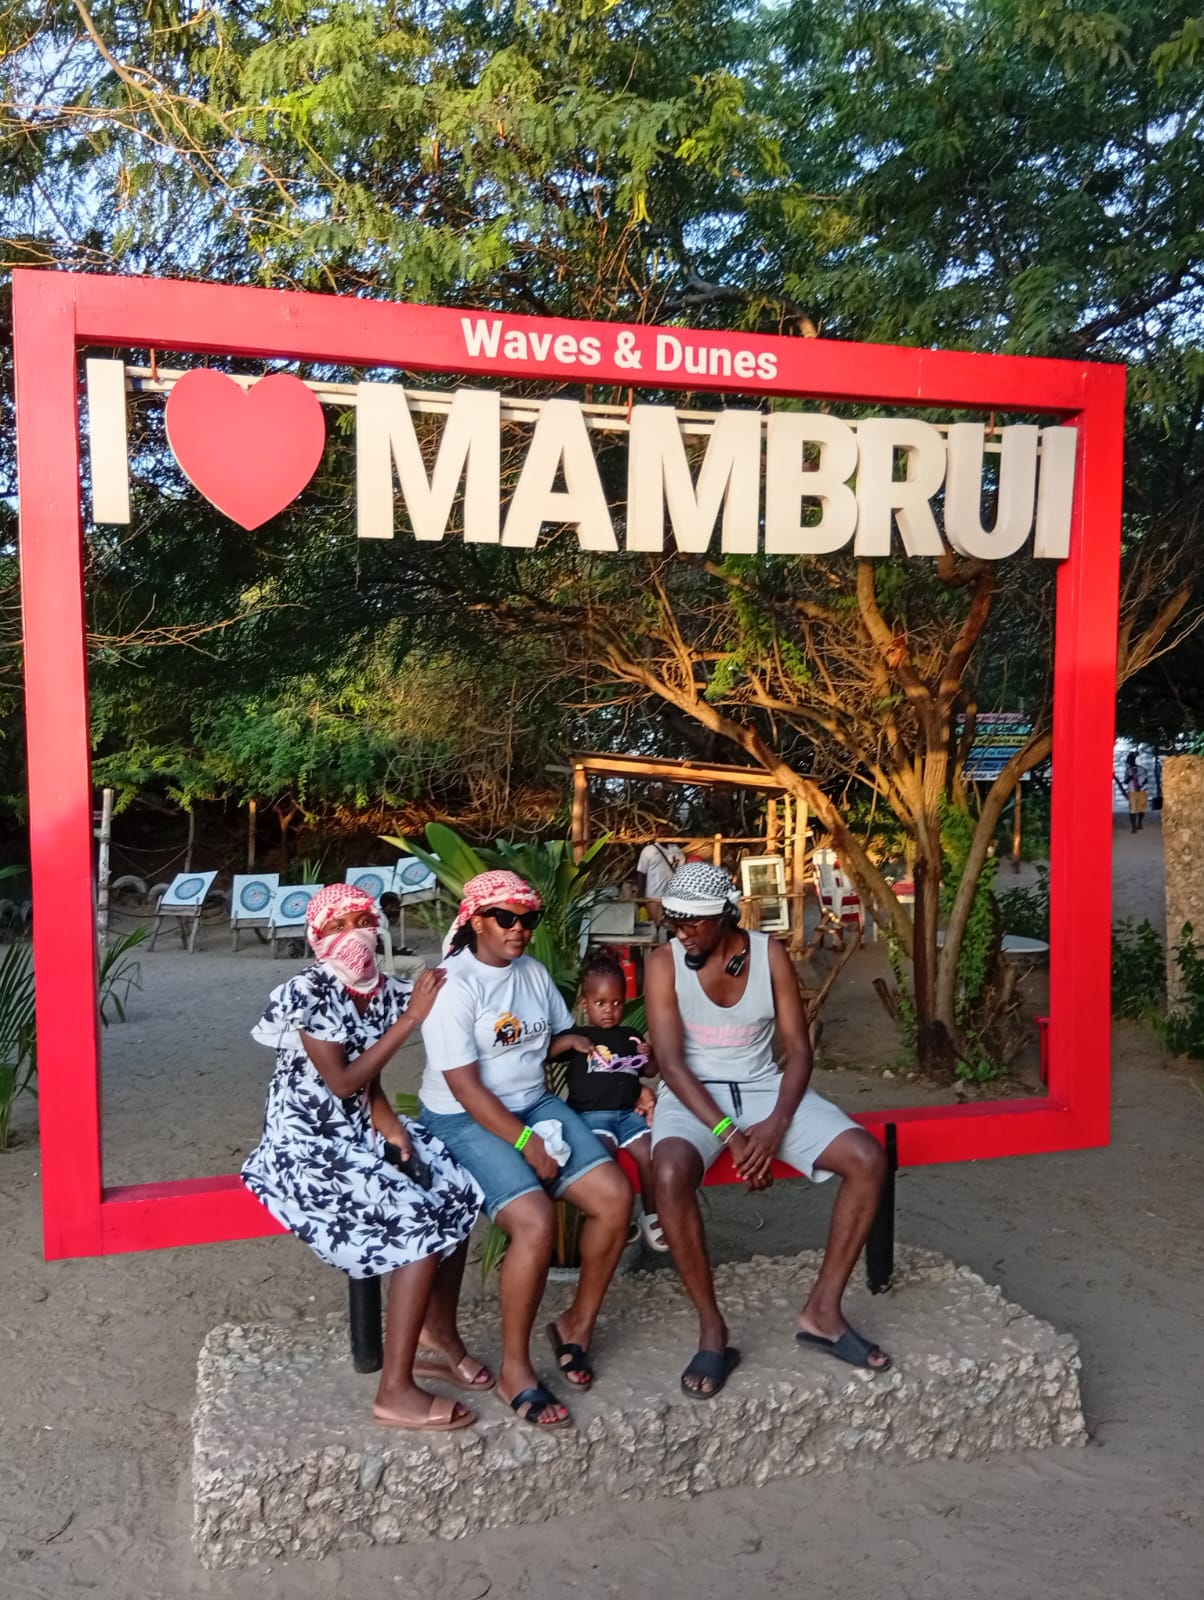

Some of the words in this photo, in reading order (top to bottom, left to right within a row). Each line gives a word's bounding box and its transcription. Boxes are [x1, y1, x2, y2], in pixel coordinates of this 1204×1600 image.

[461, 317, 601, 366] Waves
[613, 330, 643, 370] &
[656, 334, 778, 381] Dunes
[86, 358, 131, 525] I
[355, 381, 1077, 561] MAMBRUI
